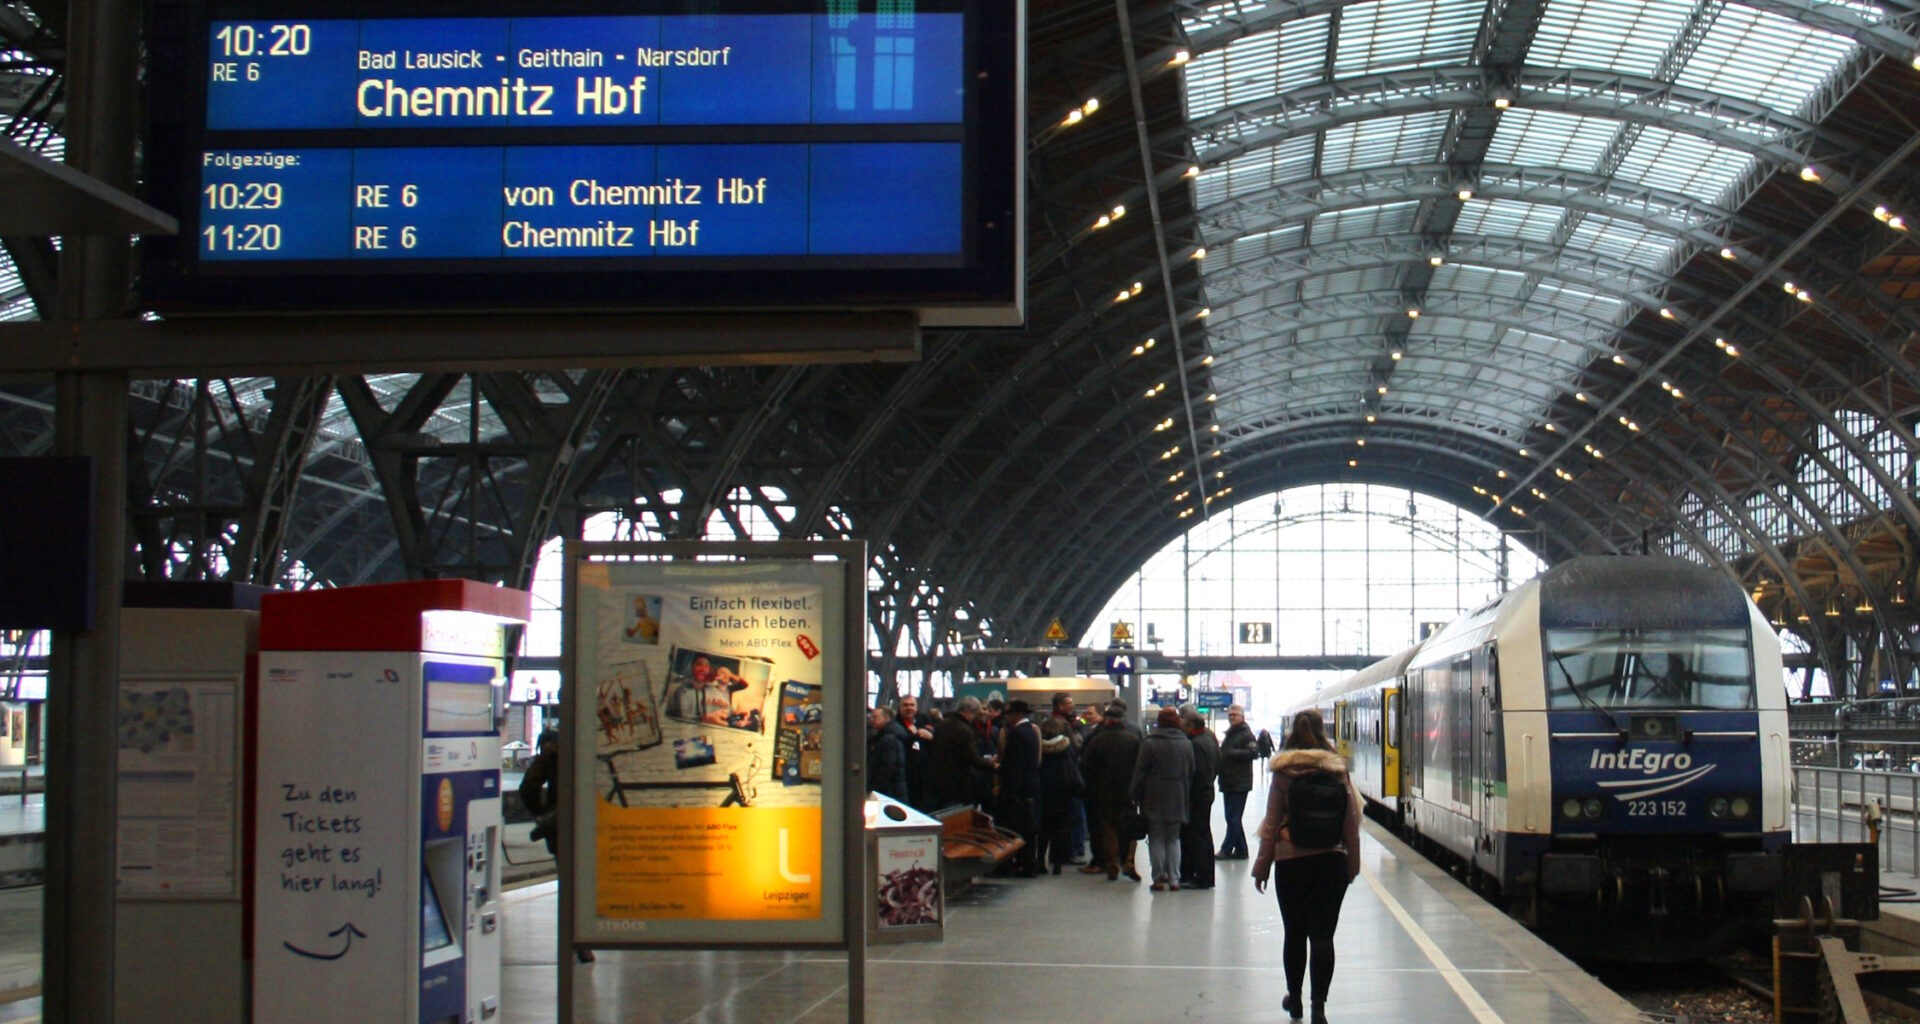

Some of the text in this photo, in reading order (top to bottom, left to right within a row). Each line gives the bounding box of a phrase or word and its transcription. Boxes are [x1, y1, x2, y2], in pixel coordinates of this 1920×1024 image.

[217, 25, 310, 55] 10:20
[359, 51, 395, 69] Bad
[406, 50, 482, 69] Lausick
[519, 49, 602, 67] Geithain
[638, 47, 730, 66] Narsdorf
[213, 63, 259, 81] RE 6
[358, 76, 646, 116] Chemnitz Hbf
[204, 153, 299, 169] Folgezüge:
[205, 178, 766, 209] 10:29 RE 6 von Chemnitz Hbf
[204, 220, 699, 250] 11:20 RE 6 Chemnitz Hbf
[690, 596, 812, 610] Einfach flexibel.
[704, 615, 811, 629] Einfach leben.
[720, 638, 793, 648] Mein ABO Flex
[1247, 624, 1264, 643] 23
[1590, 749, 1691, 774] IntEgro
[282, 784, 356, 803] Zu den
[1628, 801, 1687, 816] 223 152
[282, 812, 360, 833] Tickets
[282, 843, 360, 867] geht es
[282, 869, 382, 898] hier lang!
[763, 889, 811, 903] Leipziger
